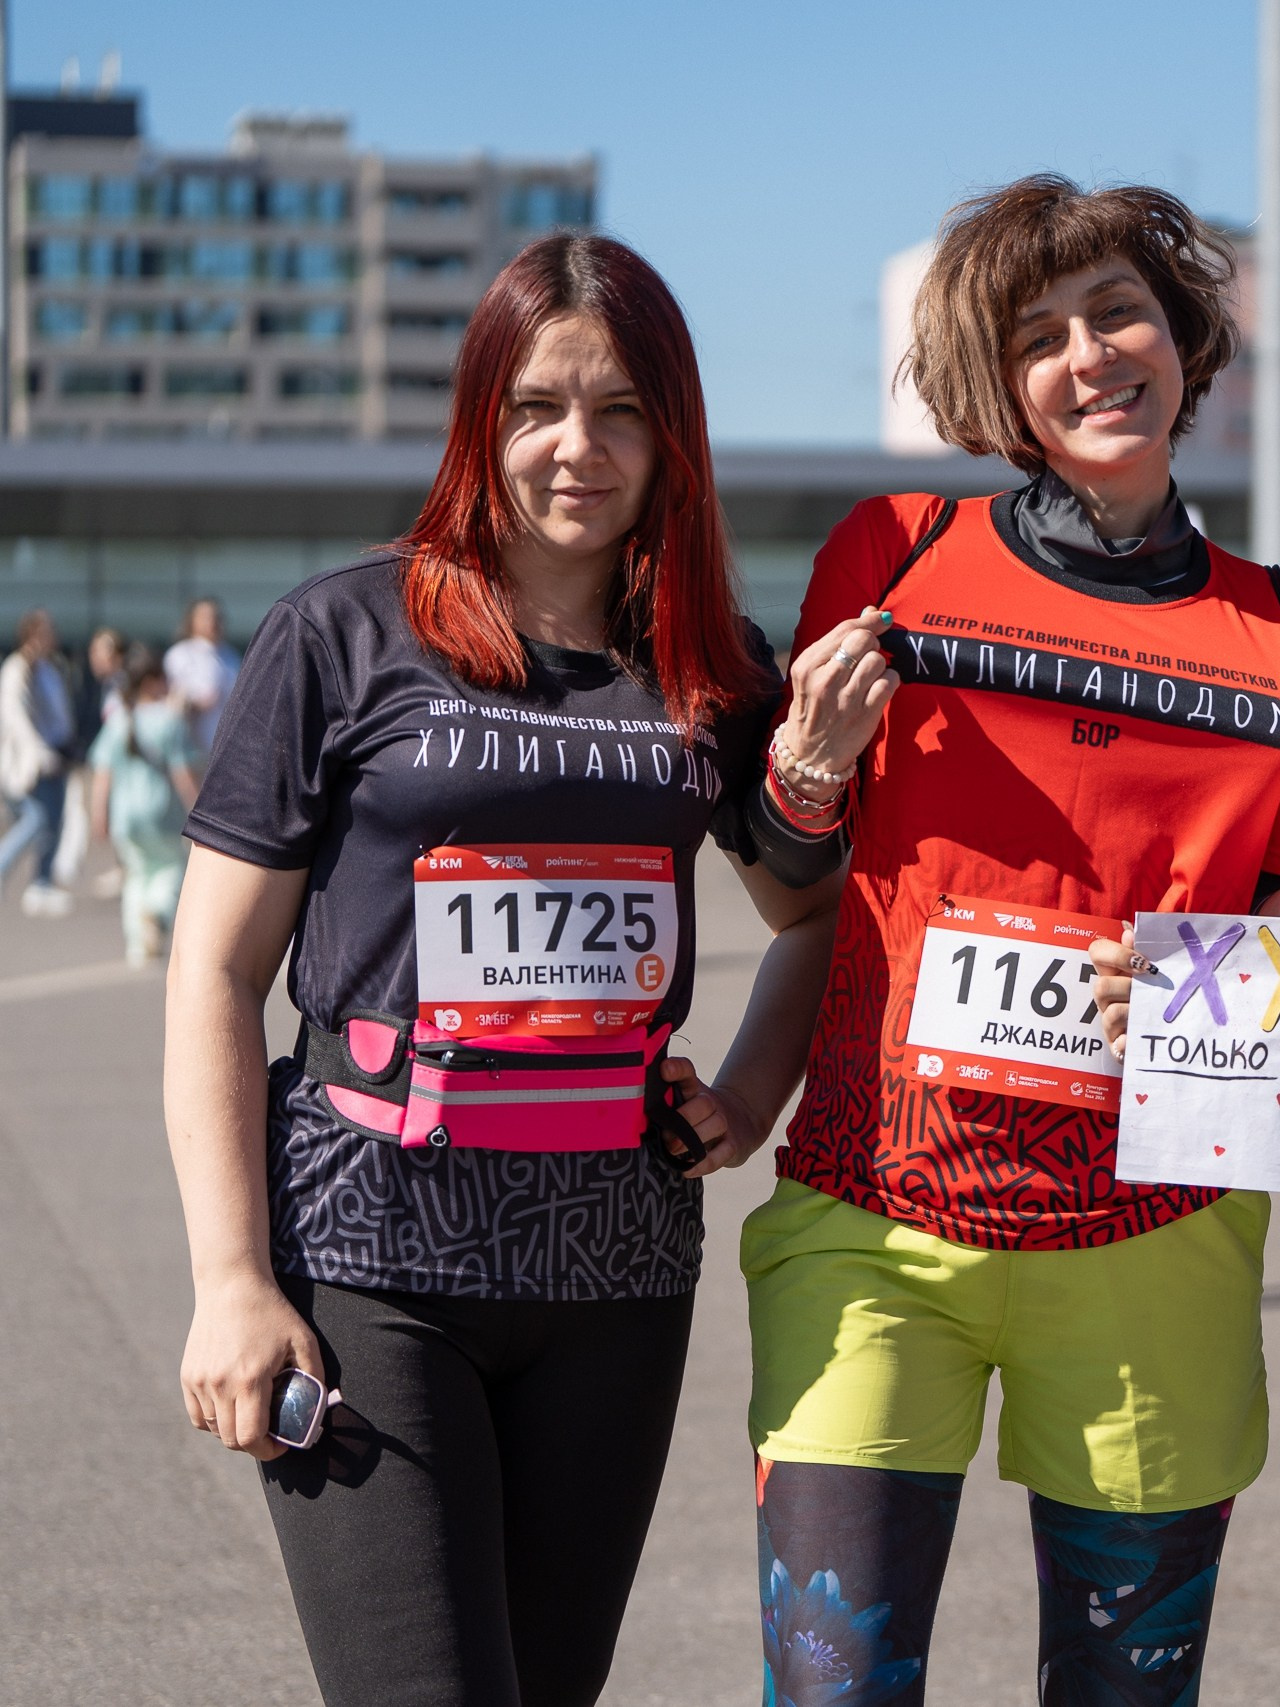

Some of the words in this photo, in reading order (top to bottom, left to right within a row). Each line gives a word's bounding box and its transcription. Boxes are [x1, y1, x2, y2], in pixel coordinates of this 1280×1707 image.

[921, 612, 977, 633] ЦЕНТР
[981, 621, 1130, 660] НАСТАВНИЧЕСТВА
[1134, 650, 1172, 670] ДЛЯ
[1176, 657, 1278, 691] ПОДРОСТКОВ
[428, 699, 477, 716] ЦЕНТР
[480, 706, 617, 732] НАСТАВНИЧЕСТВА
[620, 719, 653, 733] ДЛЯ
[1070, 718, 1120, 749] БОР
[429, 858, 438, 869] 5
[447, 891, 657, 954] 11725
[482, 964, 626, 986] ВАЛЕНТИНА
[540, 1012, 581, 1020] НИЖЕГОРОДСКАЯ
[980, 1021, 1103, 1057] ДЖАВАИР
[1140, 1034, 1269, 1072] ТОЛЬКО
[1019, 1075, 1058, 1086] НИЖЕГОРОДСКАЯ
